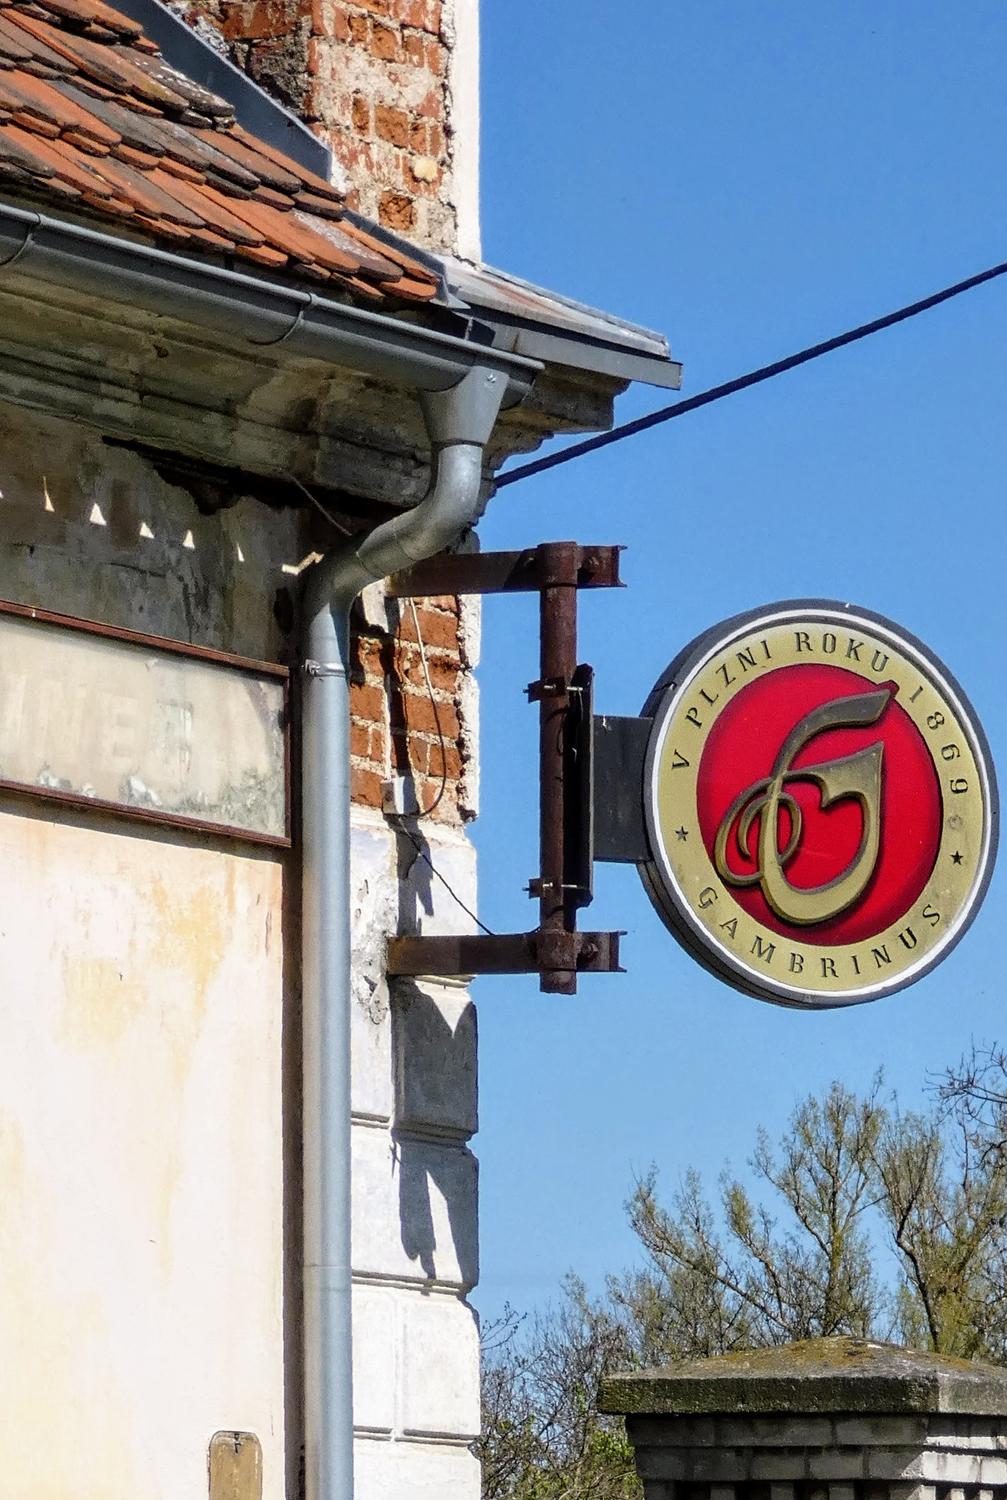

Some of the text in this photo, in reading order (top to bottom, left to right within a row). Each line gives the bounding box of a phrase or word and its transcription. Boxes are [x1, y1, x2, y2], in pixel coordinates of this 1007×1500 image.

[671, 631, 969, 795] V PLZNI ROKU 1869
[697, 886, 942, 979] GAMBRINUS
